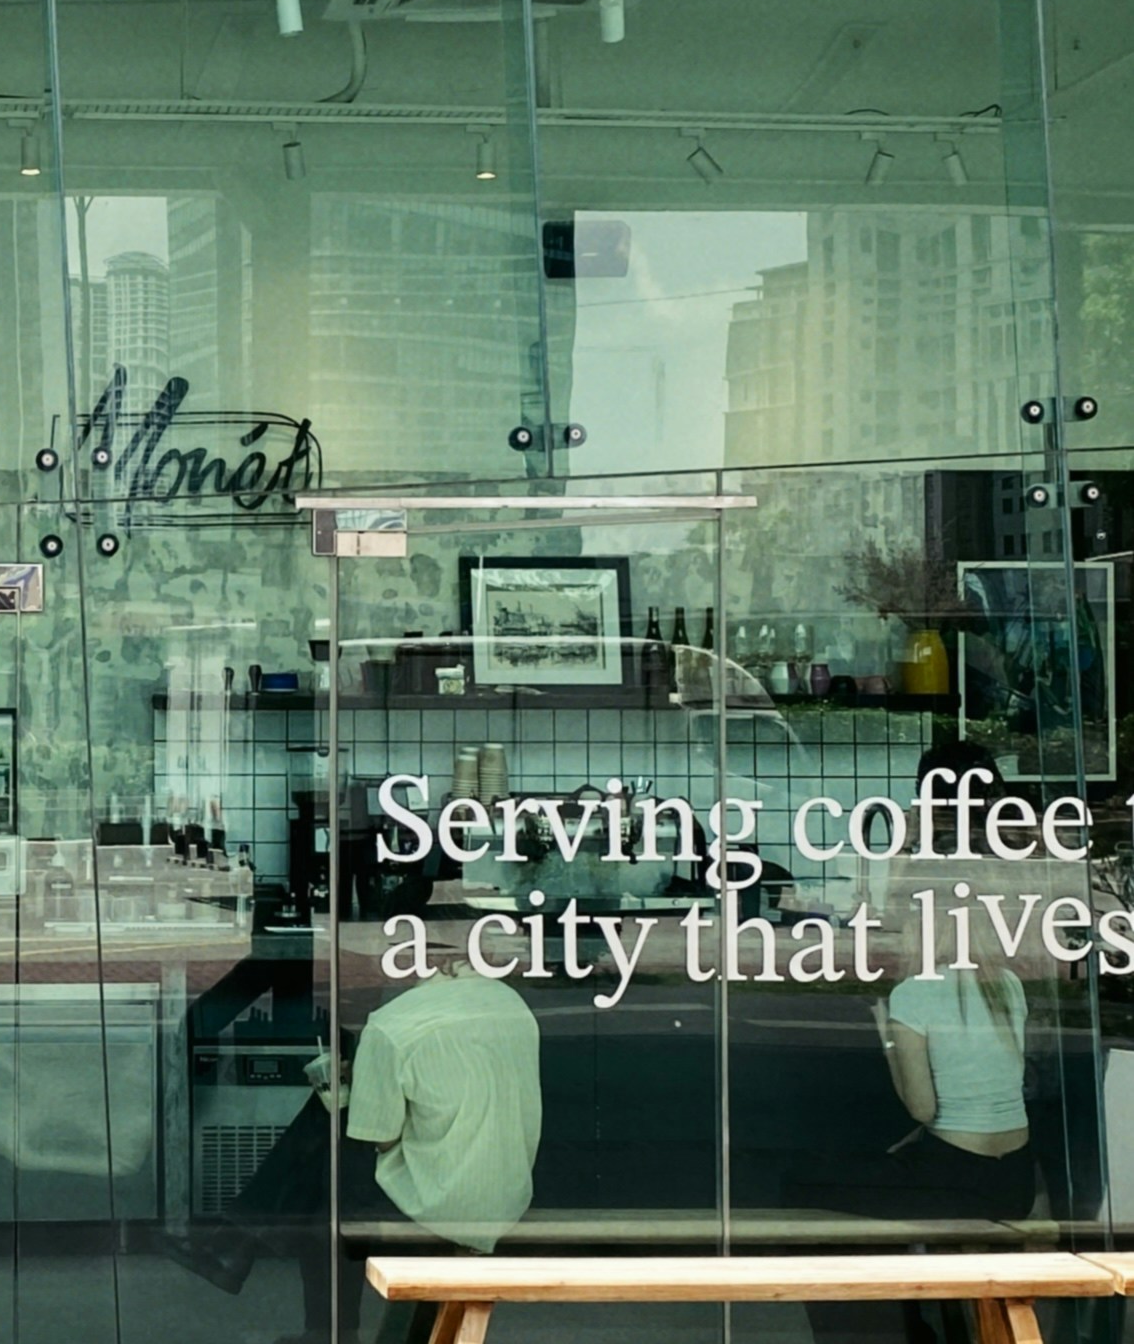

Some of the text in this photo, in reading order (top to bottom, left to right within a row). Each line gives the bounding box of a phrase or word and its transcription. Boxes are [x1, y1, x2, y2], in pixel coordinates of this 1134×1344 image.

[376, 774, 762, 889] Serving
[792, 768, 1093, 862] coffee
[380, 882, 1134, 1010] a city that lives
